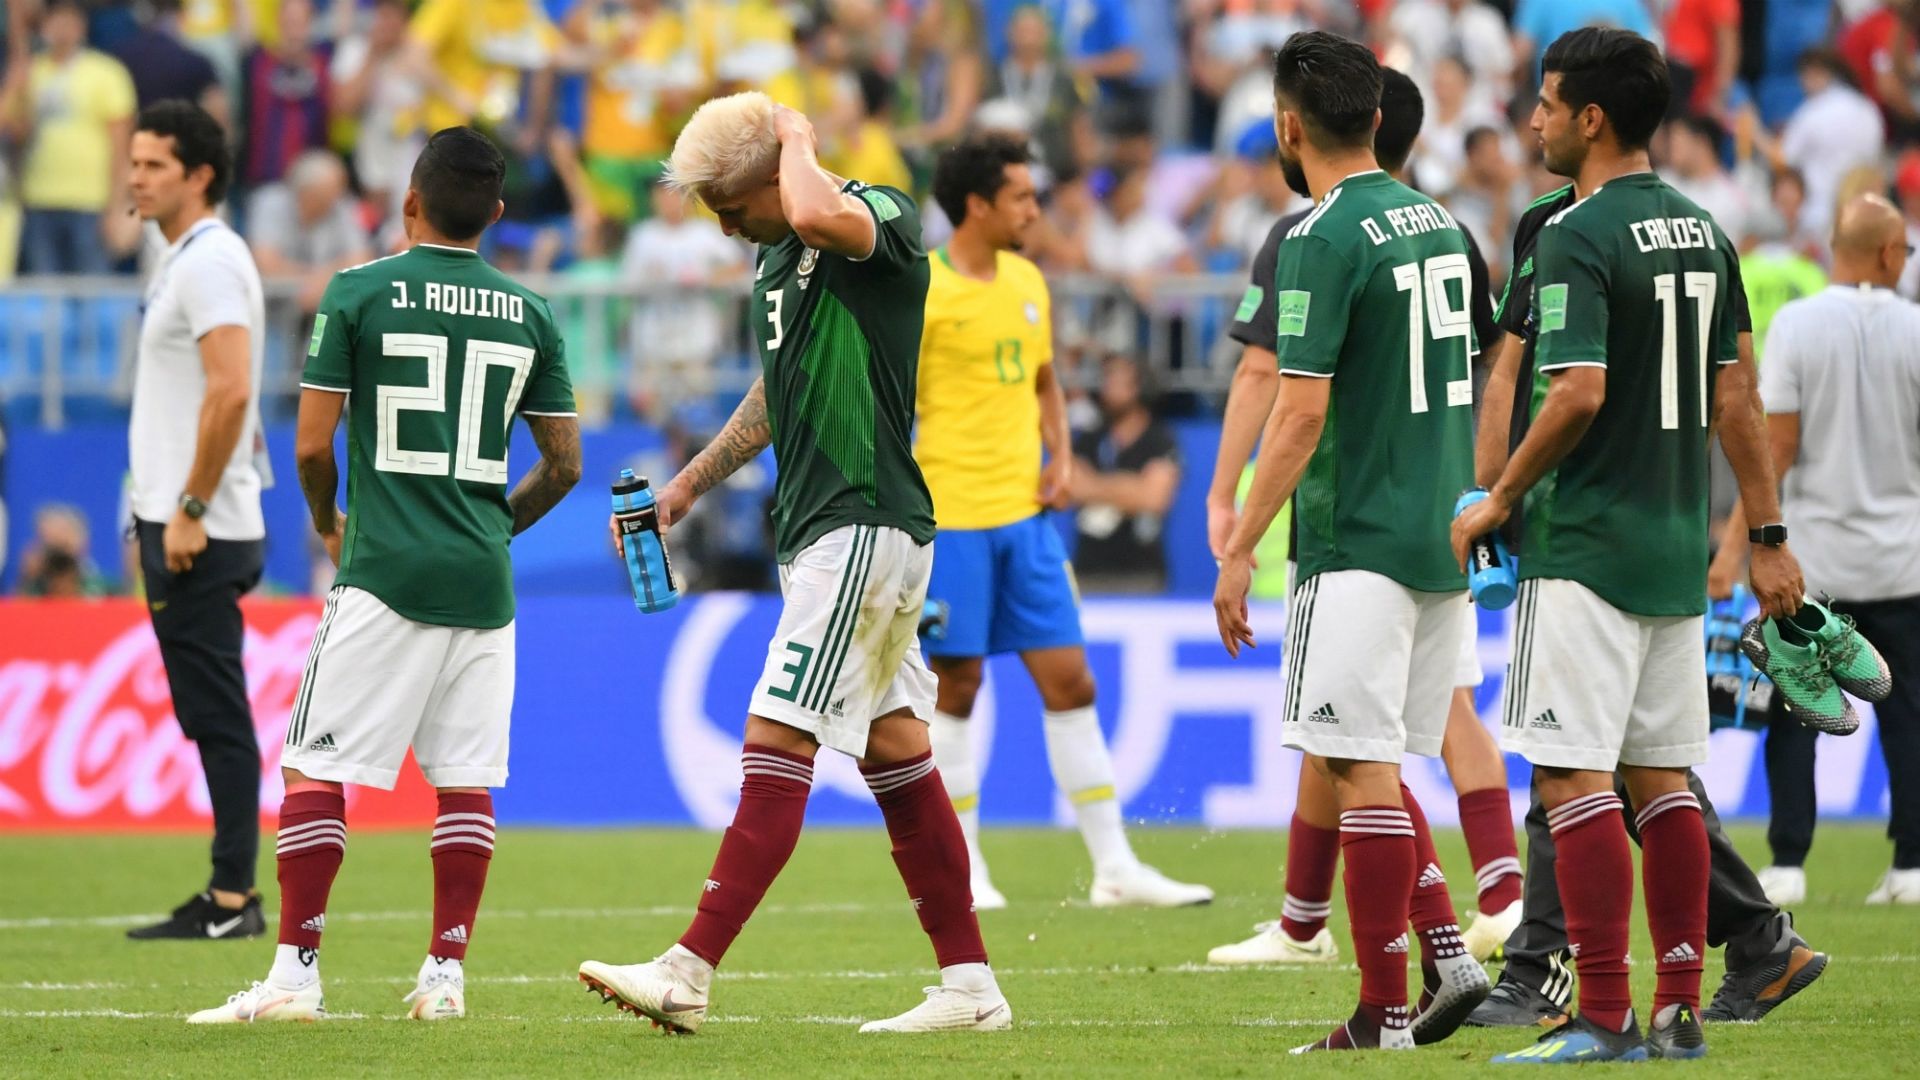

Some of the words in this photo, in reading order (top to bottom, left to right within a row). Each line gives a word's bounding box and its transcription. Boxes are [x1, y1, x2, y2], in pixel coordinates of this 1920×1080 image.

[391, 281, 416, 309] J.
[425, 282, 524, 324] AQUINO
[765, 289, 784, 350] 3
[1392, 253, 1473, 414] 19
[375, 333, 536, 485] 20
[767, 641, 814, 703] 3
